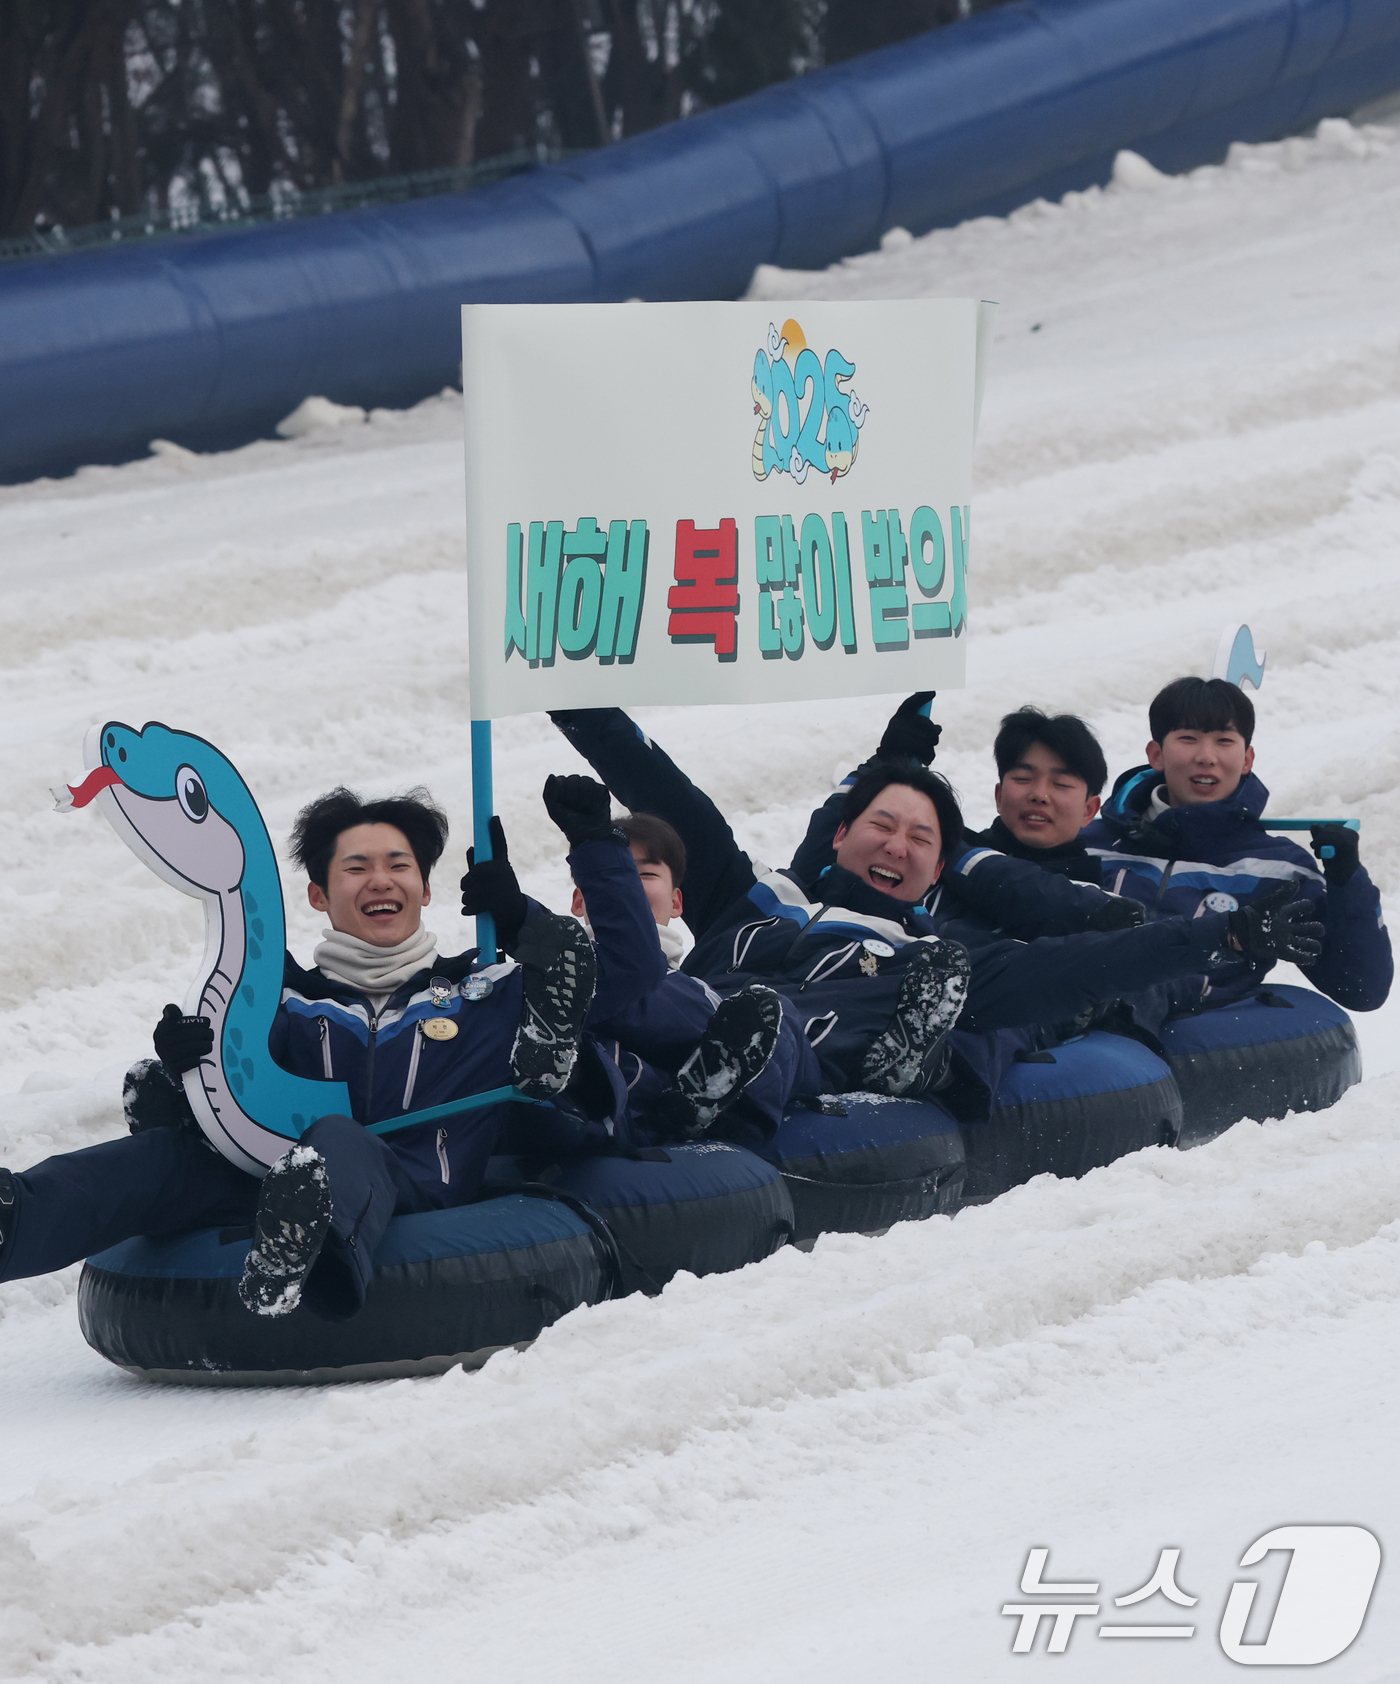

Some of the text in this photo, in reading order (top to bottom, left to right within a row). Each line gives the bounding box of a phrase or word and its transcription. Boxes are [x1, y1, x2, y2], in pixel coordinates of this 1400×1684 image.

[751, 348, 859, 484] 2025
[505, 517, 649, 668] 새해
[667, 518, 739, 662] 복
[755, 512, 857, 661] 많이
